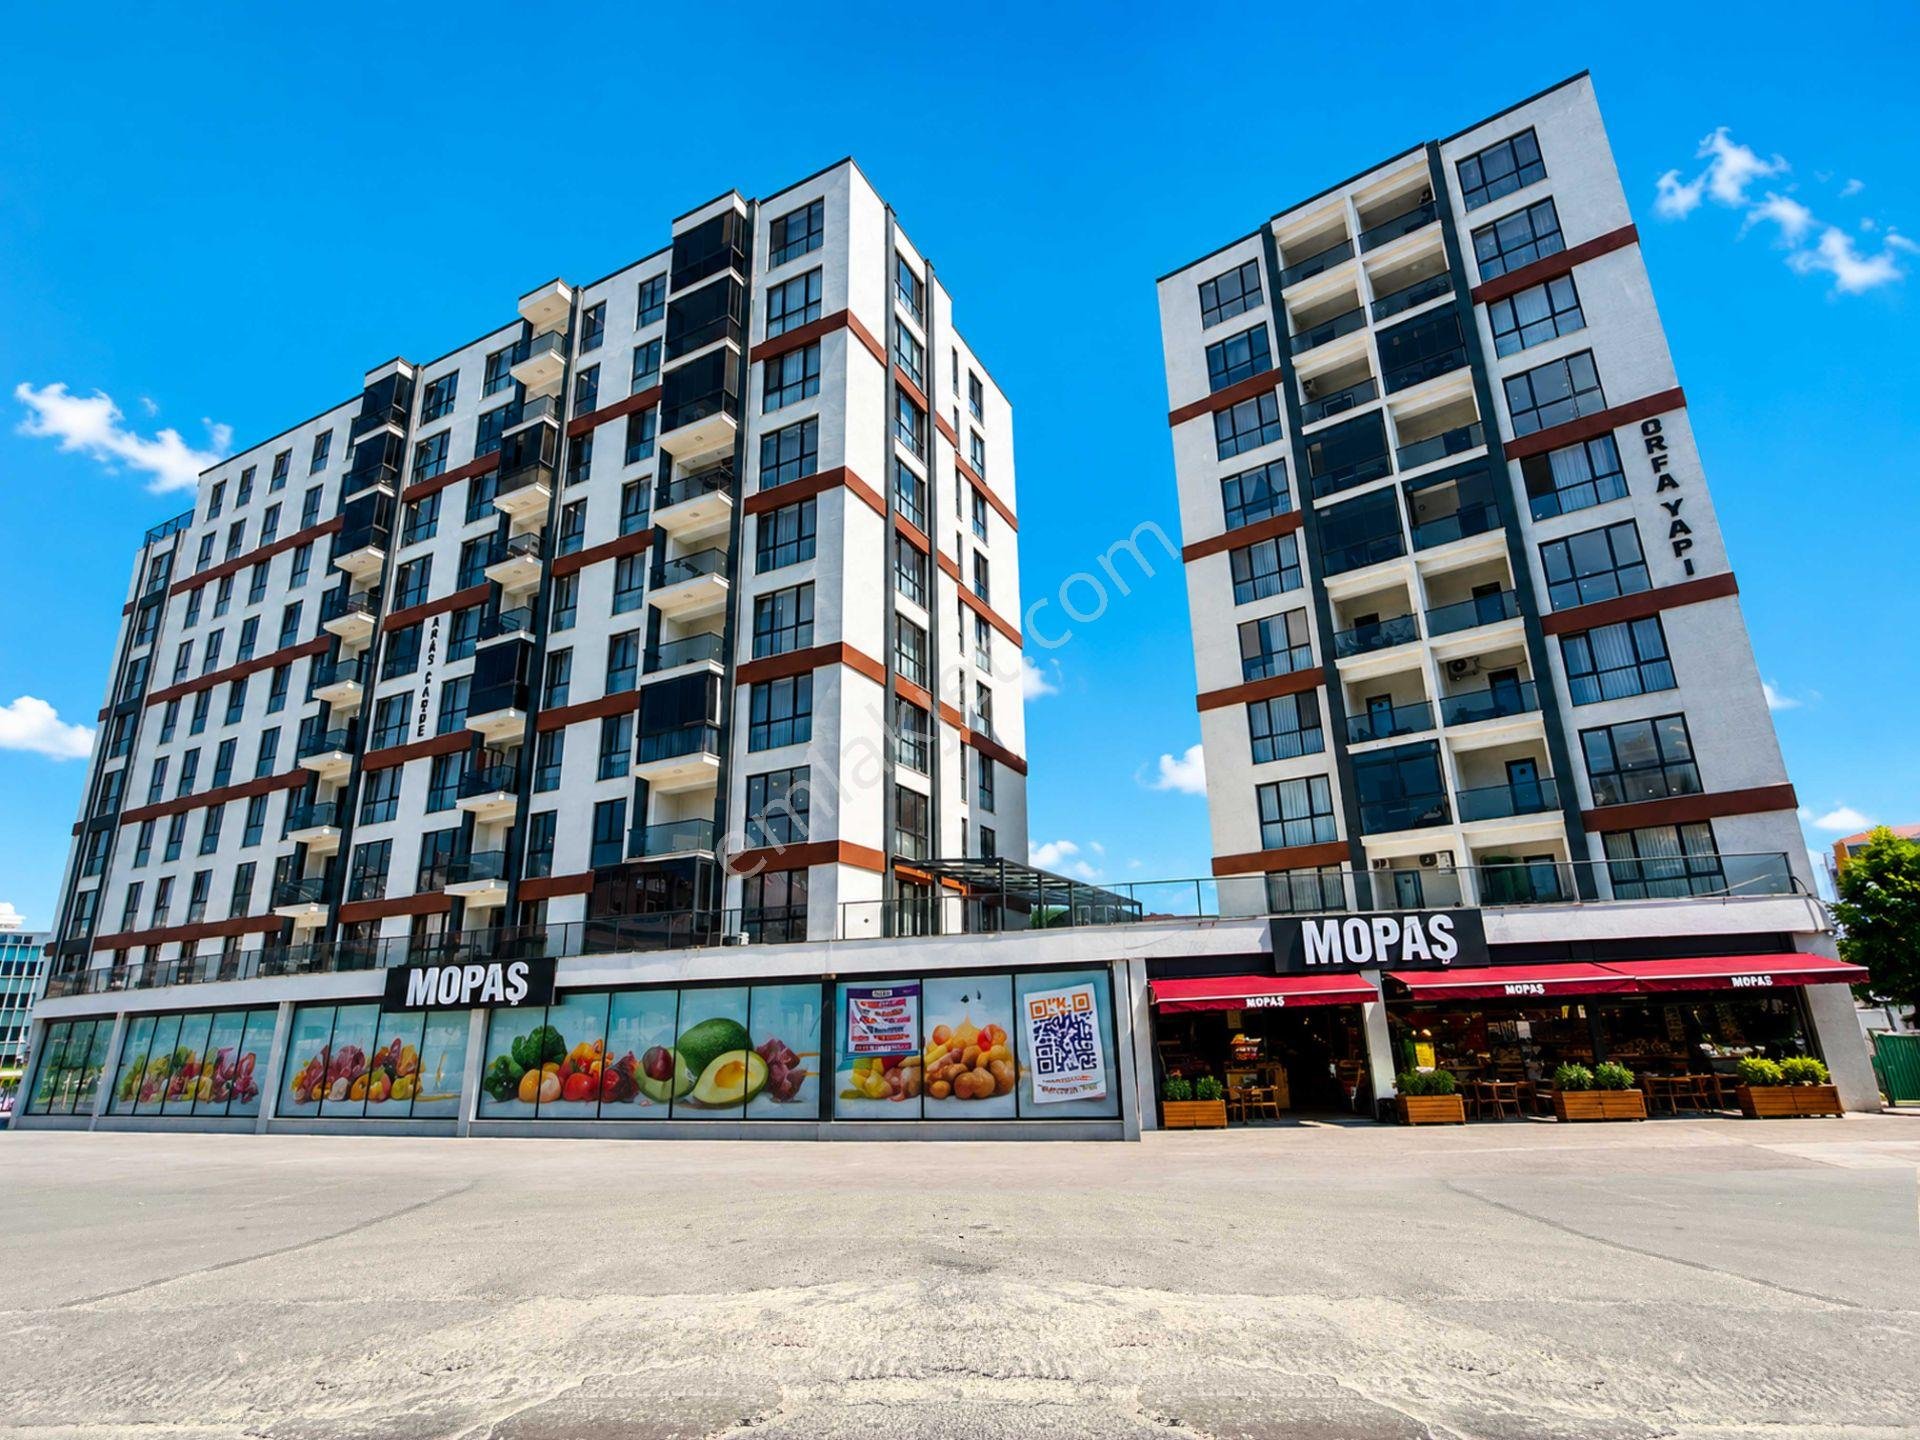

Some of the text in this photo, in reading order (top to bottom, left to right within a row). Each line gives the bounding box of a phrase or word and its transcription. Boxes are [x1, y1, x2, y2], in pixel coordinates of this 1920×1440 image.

[1640, 418, 1695, 576] ORFA YAPI
[427, 616, 440, 665] ARAS
[1301, 914, 1459, 965] MOPAŞ
[405, 961, 529, 1006] MOPAŞ
